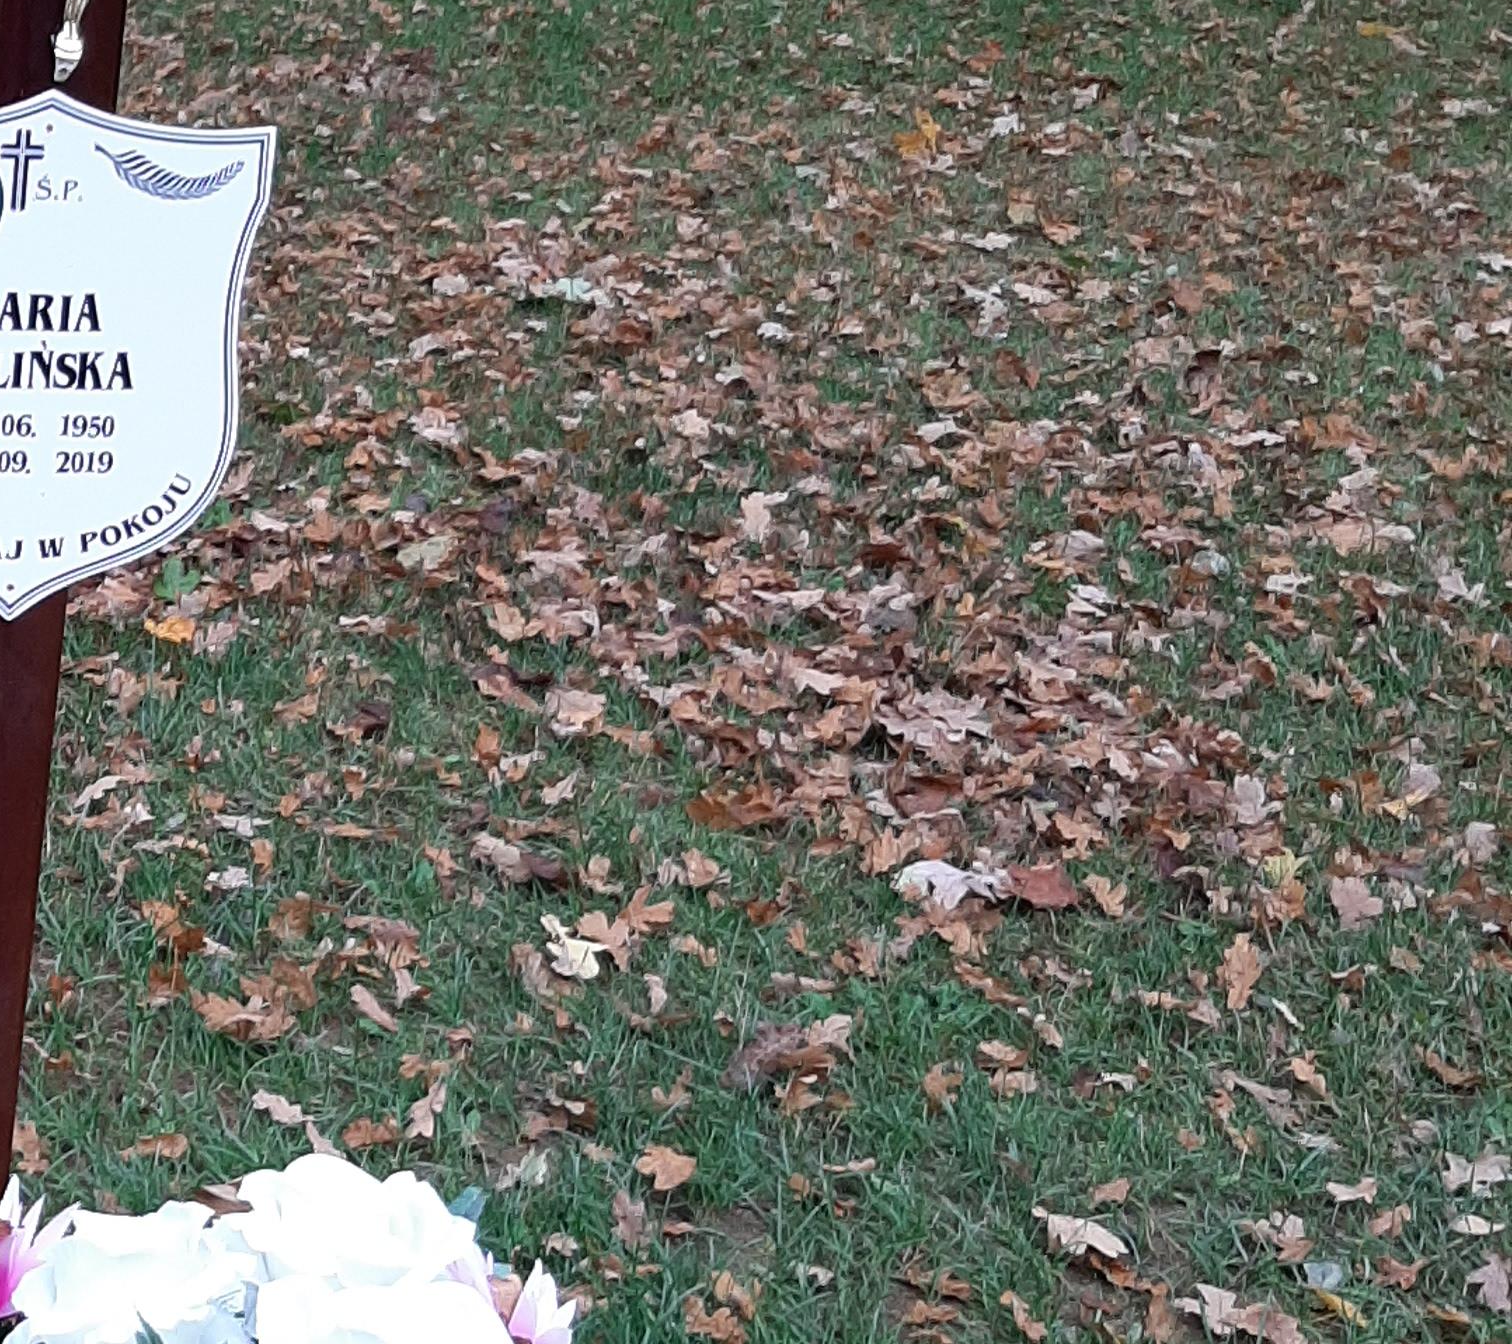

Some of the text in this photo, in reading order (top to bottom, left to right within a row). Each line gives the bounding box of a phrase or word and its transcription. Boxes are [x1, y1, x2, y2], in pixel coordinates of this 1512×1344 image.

[1, 413, 36, 438] 06.
[59, 414, 115, 438] 1950
[55, 450, 114, 474] 2019
[38, 536, 65, 559] W
[80, 472, 192, 554] POKOJU
